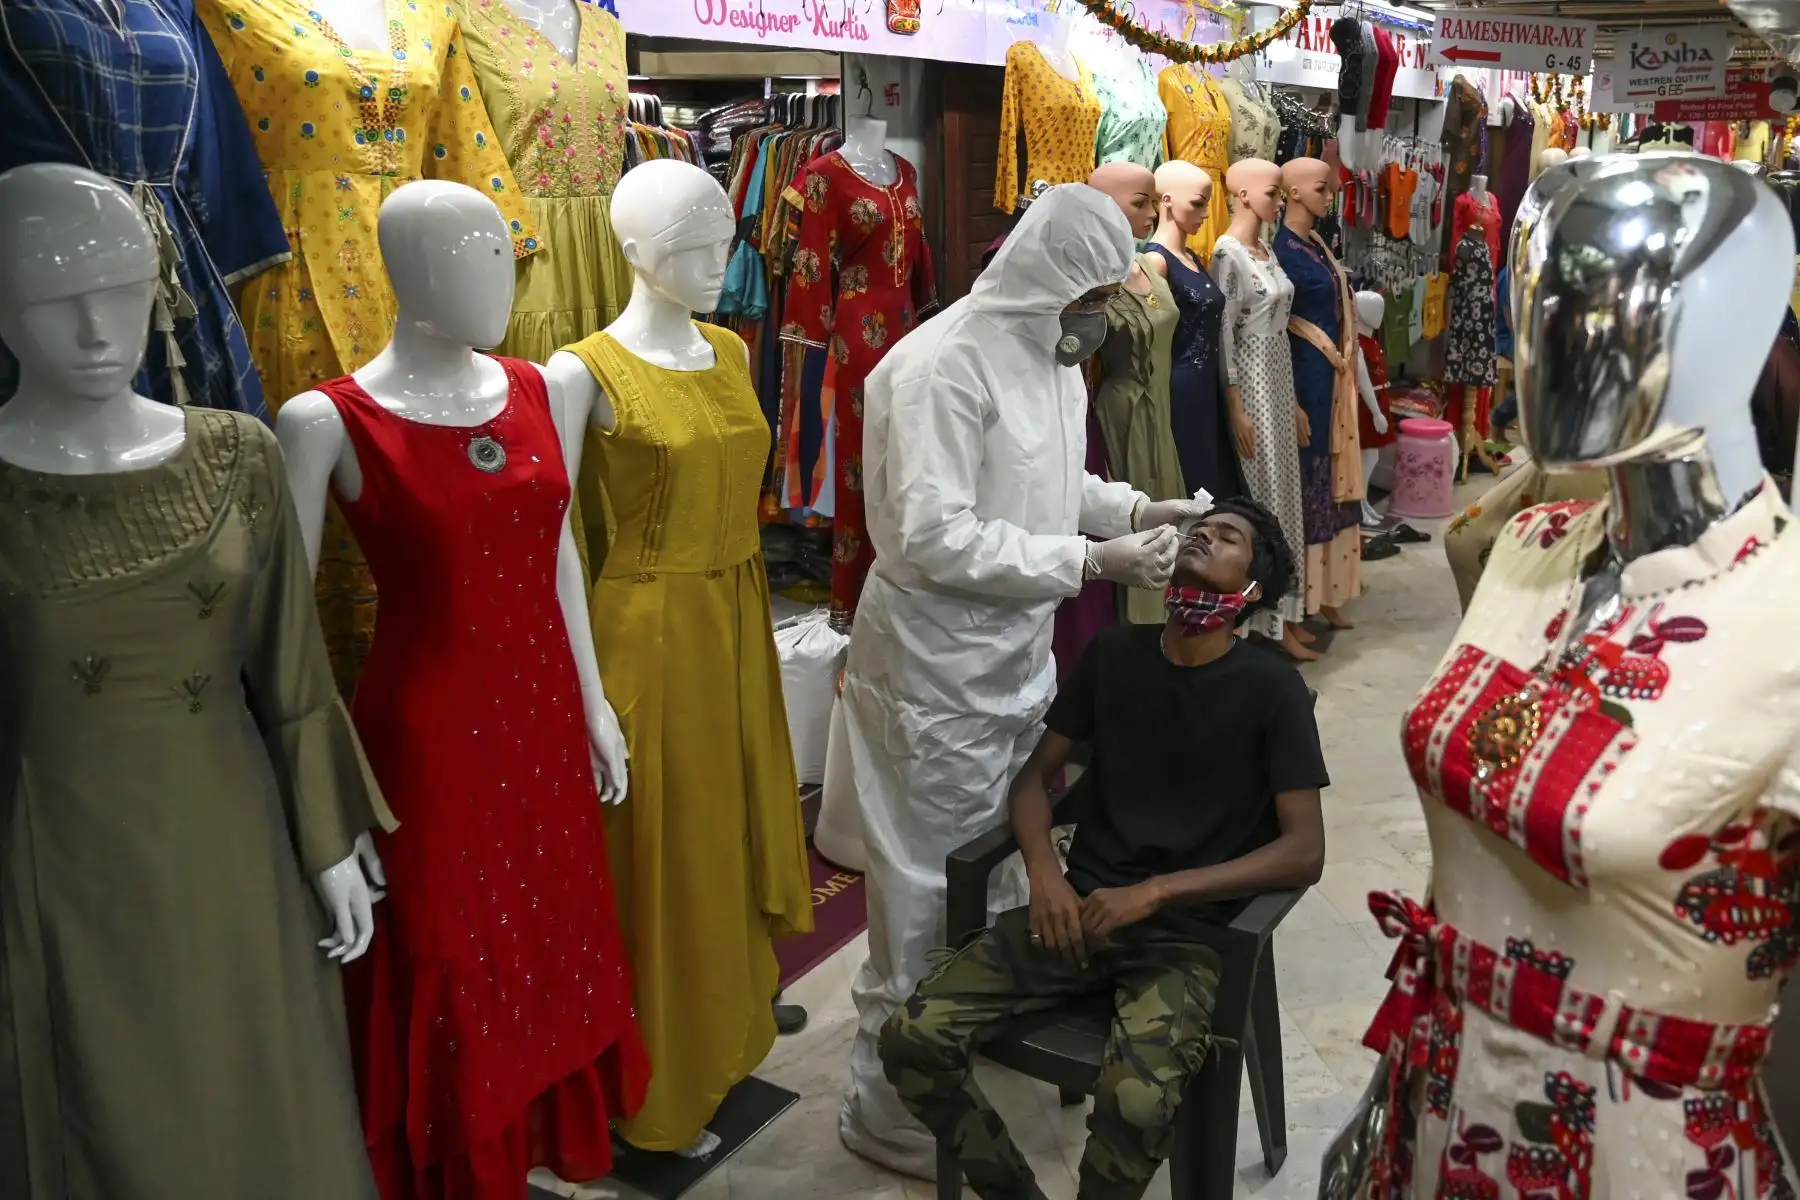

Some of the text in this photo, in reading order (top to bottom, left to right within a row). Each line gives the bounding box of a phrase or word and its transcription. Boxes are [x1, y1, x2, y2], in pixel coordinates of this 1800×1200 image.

[695, 0, 870, 41] Designer Kurtis
[1545, 54, 1555, 69] G
[1566, 56, 1581, 71] 45
[1674, 75, 1692, 83] OUT
